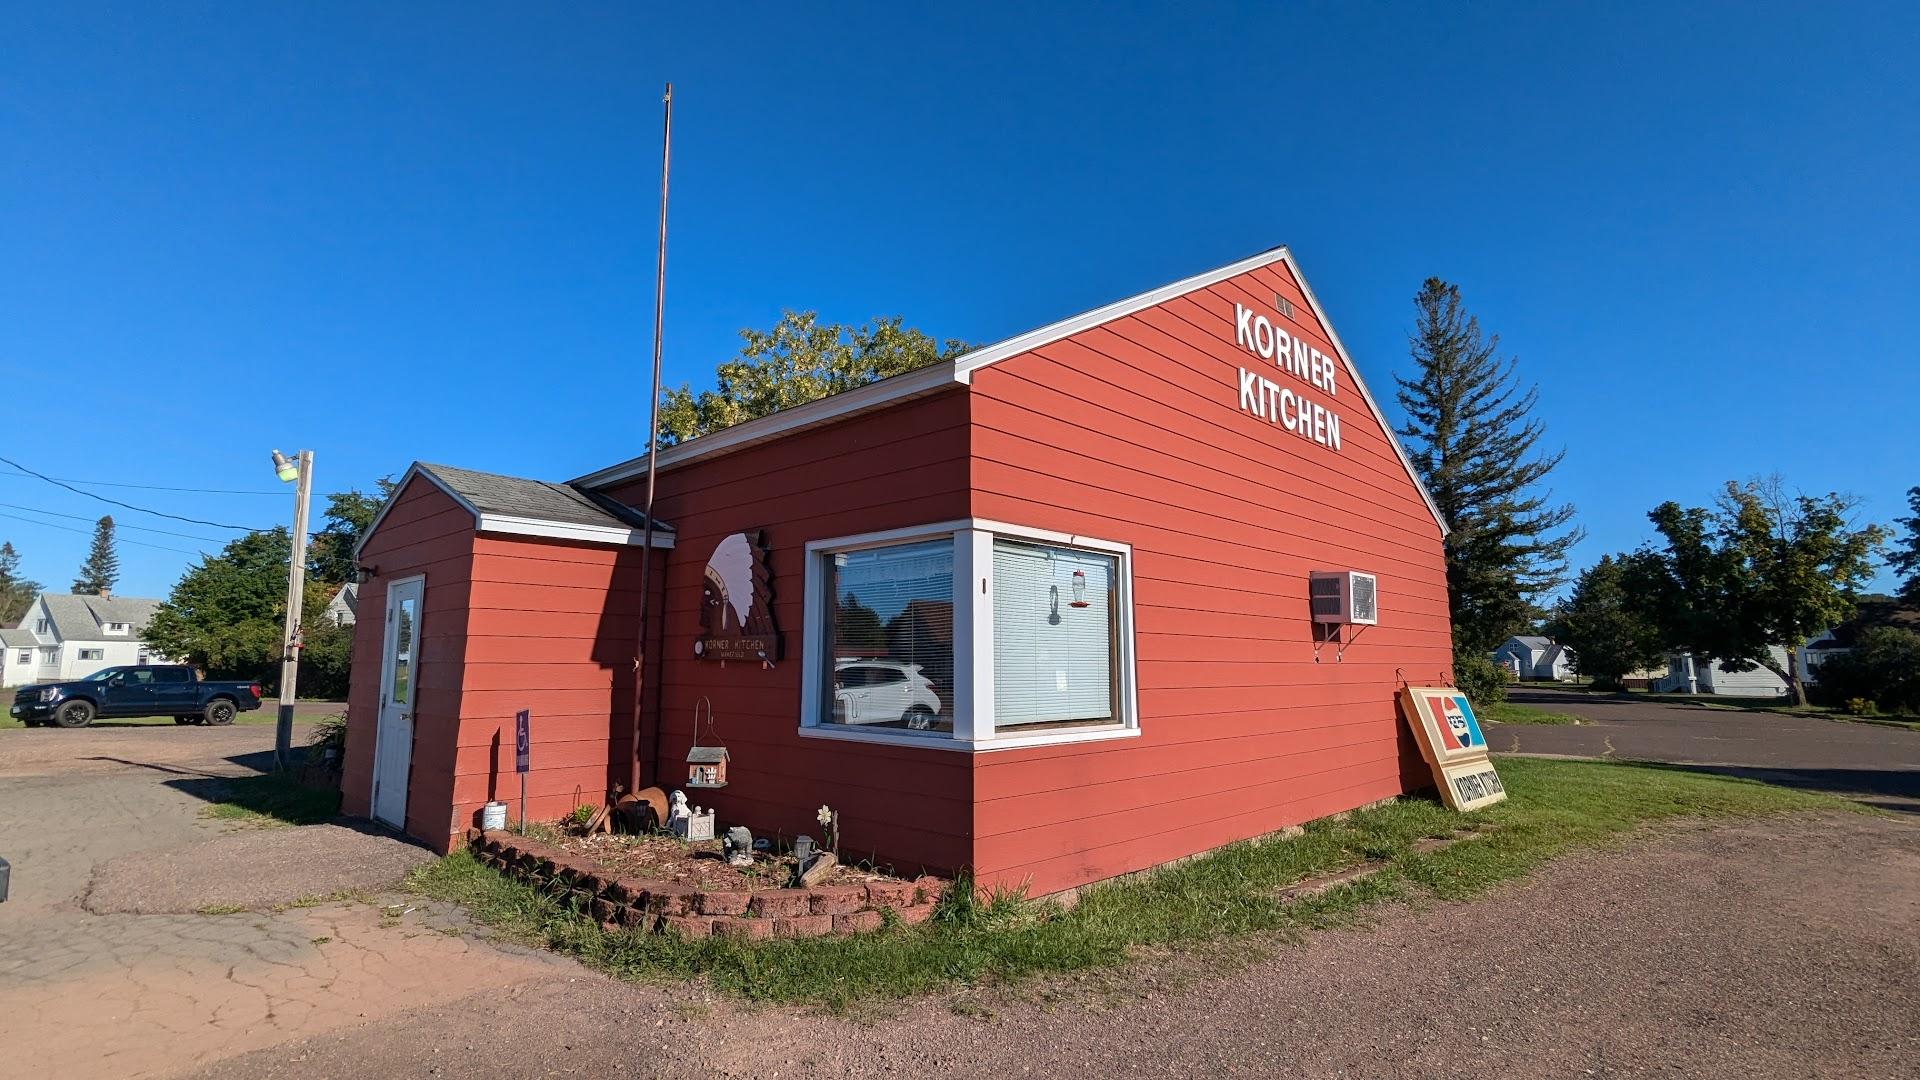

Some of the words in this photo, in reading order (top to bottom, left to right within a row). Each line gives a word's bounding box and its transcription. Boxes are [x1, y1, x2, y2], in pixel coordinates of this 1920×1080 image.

[1234, 303, 1336, 396] KORNER
[1238, 367, 1341, 451] KITCHEN
[704, 639, 729, 650] KORNER
[735, 639, 764, 650] KITCHEN
